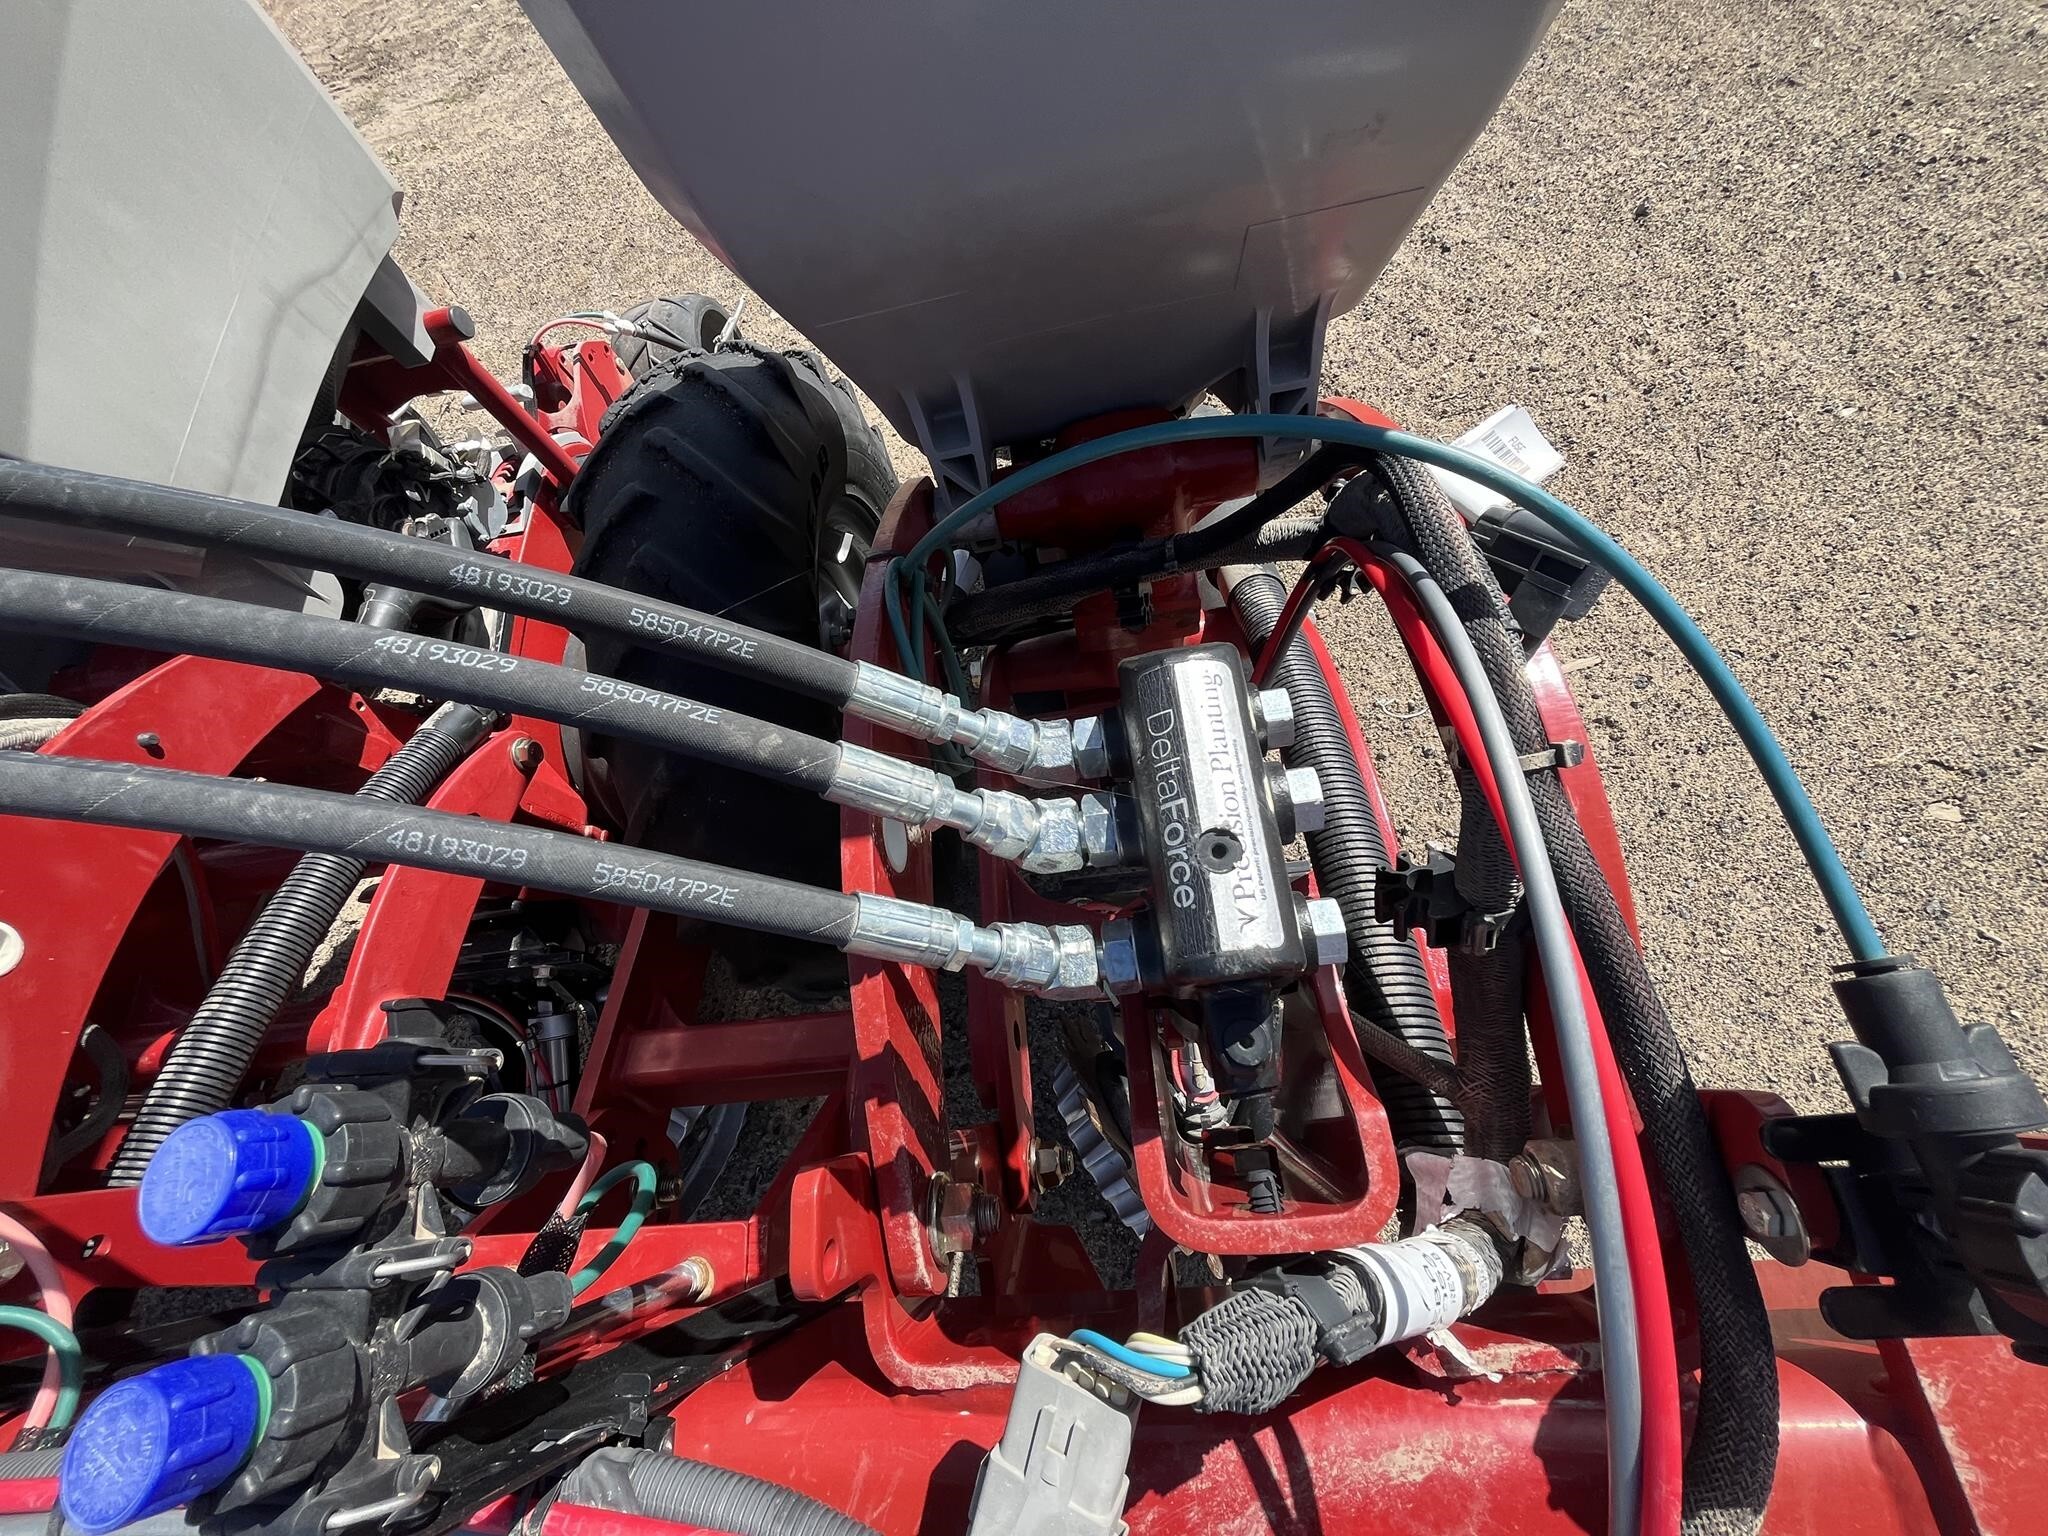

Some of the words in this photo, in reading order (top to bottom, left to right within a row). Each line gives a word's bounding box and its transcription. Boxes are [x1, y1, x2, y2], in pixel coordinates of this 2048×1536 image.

[450, 563, 572, 605] 48193029
[628, 608, 758, 659] 585047P2E
[374, 635, 518, 672] 48193029
[579, 676, 723, 724] 585047P2E
[1201, 673, 1233, 774] Planting
[1147, 708, 1196, 909] DeltaForce
[386, 829, 528, 869] 48193029
[592, 862, 740, 908] 585047P2E
